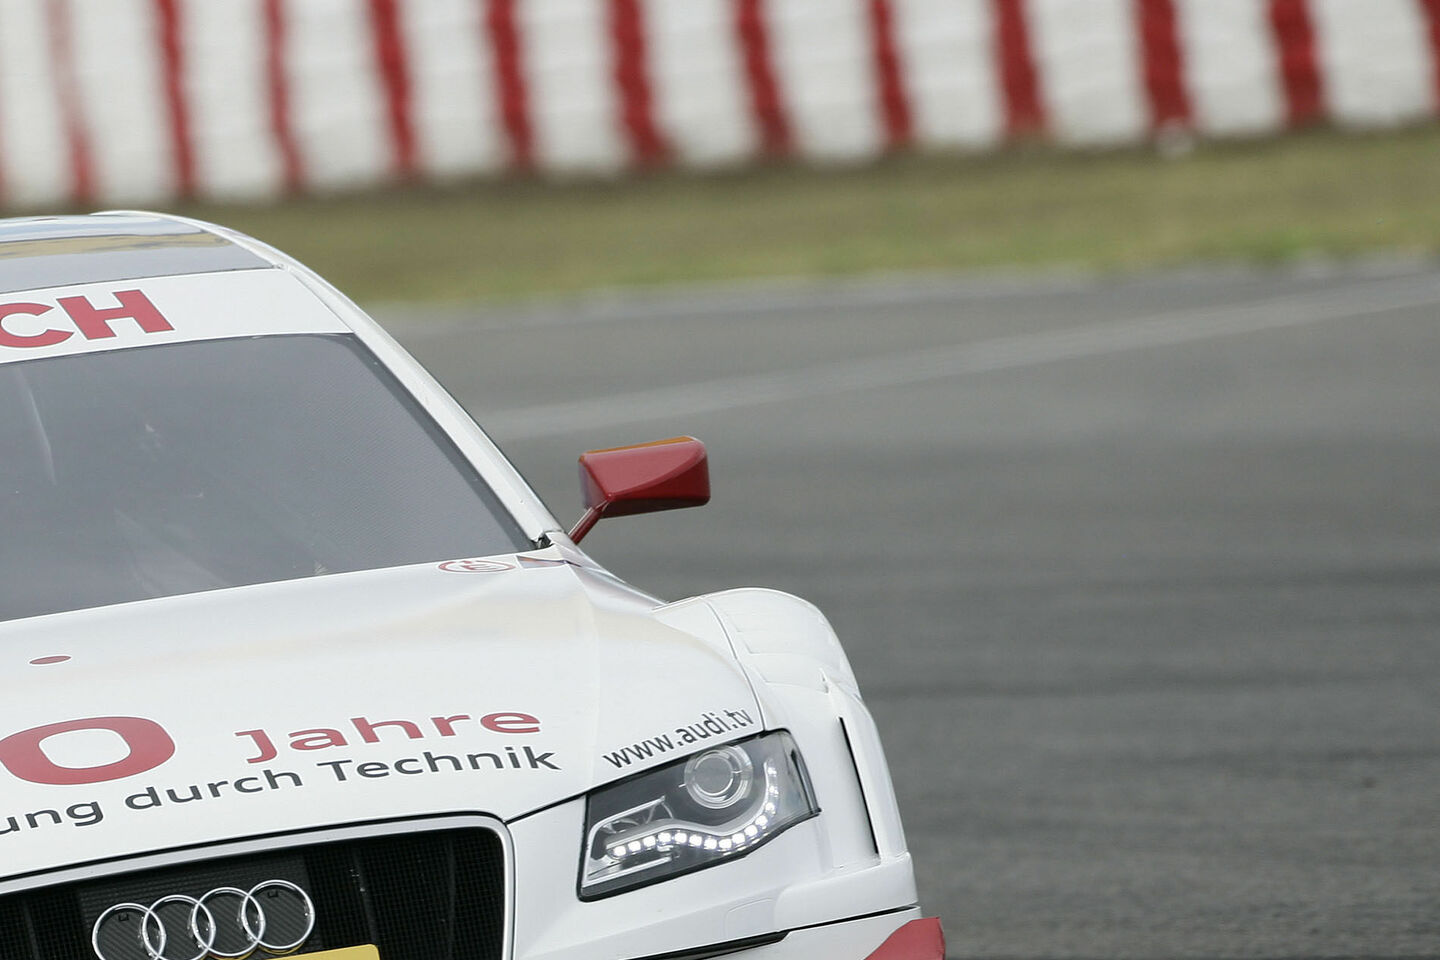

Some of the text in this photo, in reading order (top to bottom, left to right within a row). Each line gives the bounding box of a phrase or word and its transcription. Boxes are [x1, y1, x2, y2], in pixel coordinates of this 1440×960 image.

[234, 710, 542, 764] Jahre
[603, 706, 754, 769] www.audi.tv
[124, 768, 303, 810] durch
[317, 746, 561, 781] Technik
